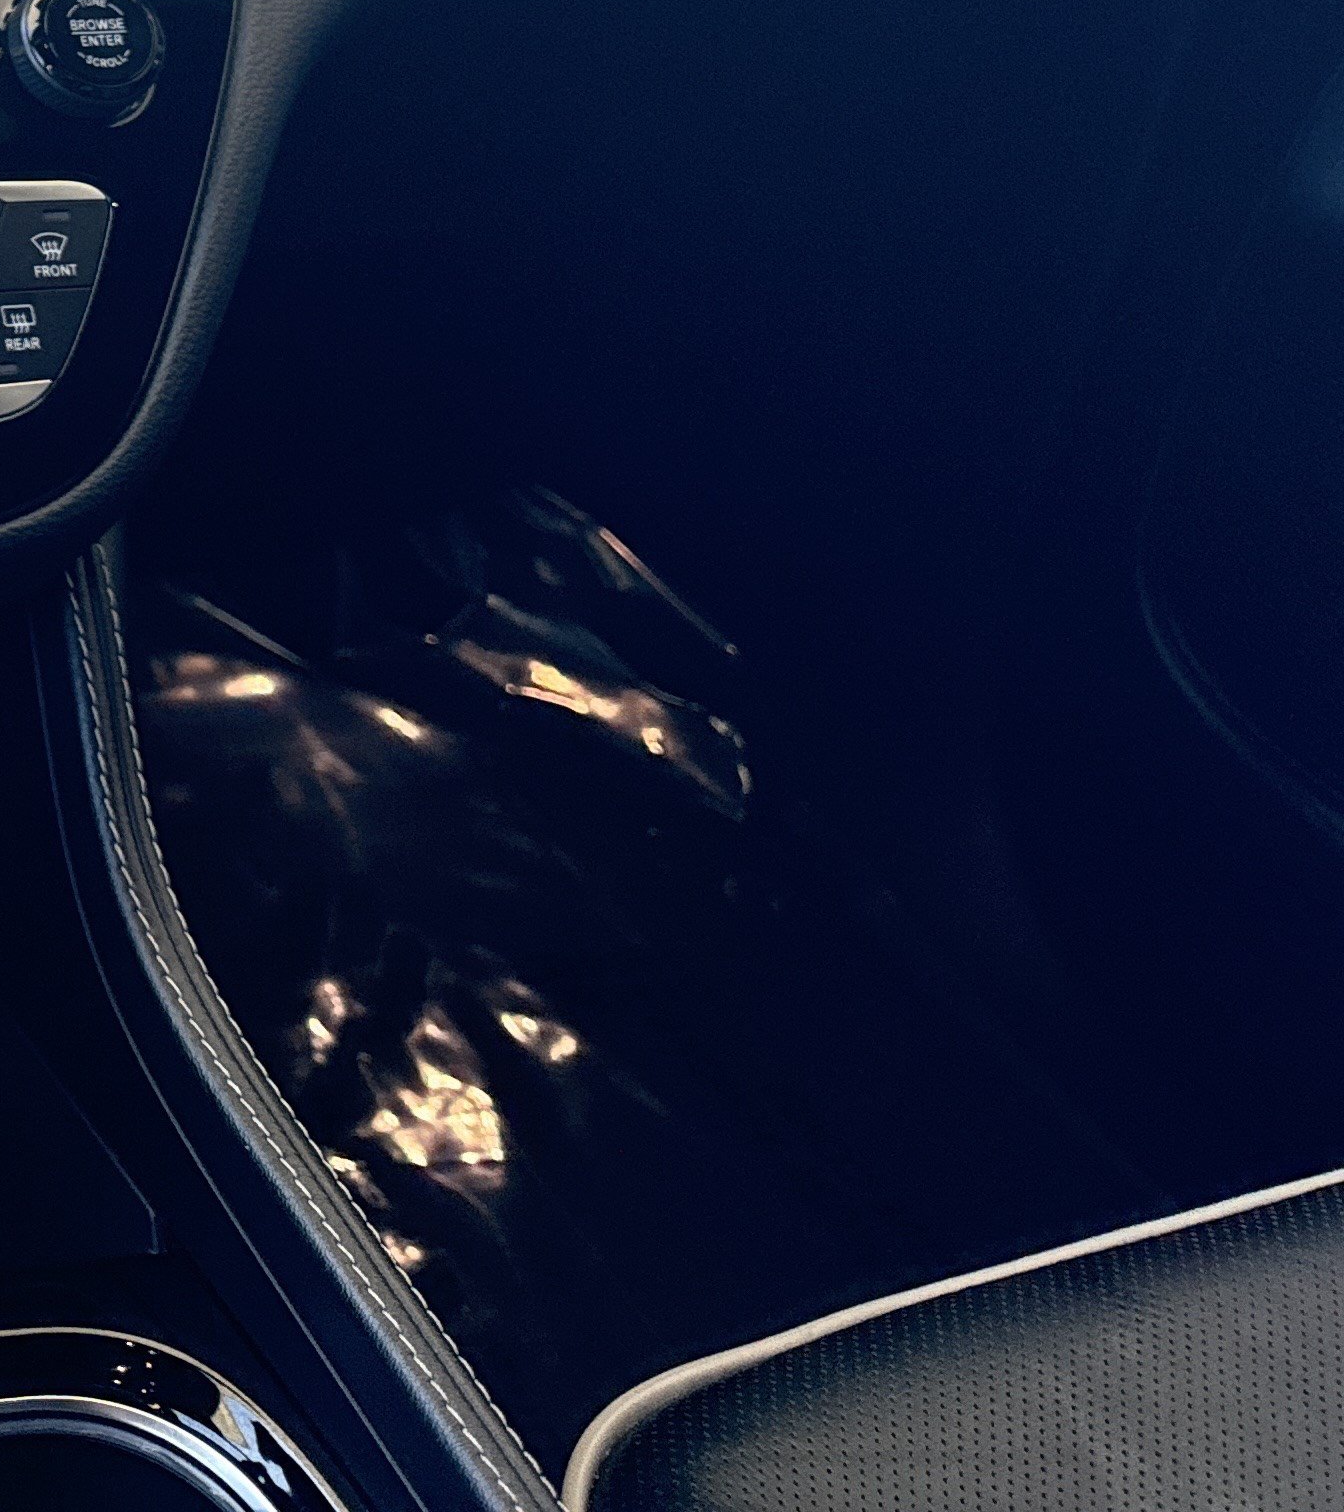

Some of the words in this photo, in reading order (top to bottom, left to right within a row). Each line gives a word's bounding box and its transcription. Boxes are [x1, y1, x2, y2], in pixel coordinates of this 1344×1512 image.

[69, 17, 126, 30] BROWSE
[80, 34, 125, 47] ENTER
[85, 54, 130, 68] SCROLL
[33, 264, 78, 278] FRONT
[4, 336, 42, 352] REAR
